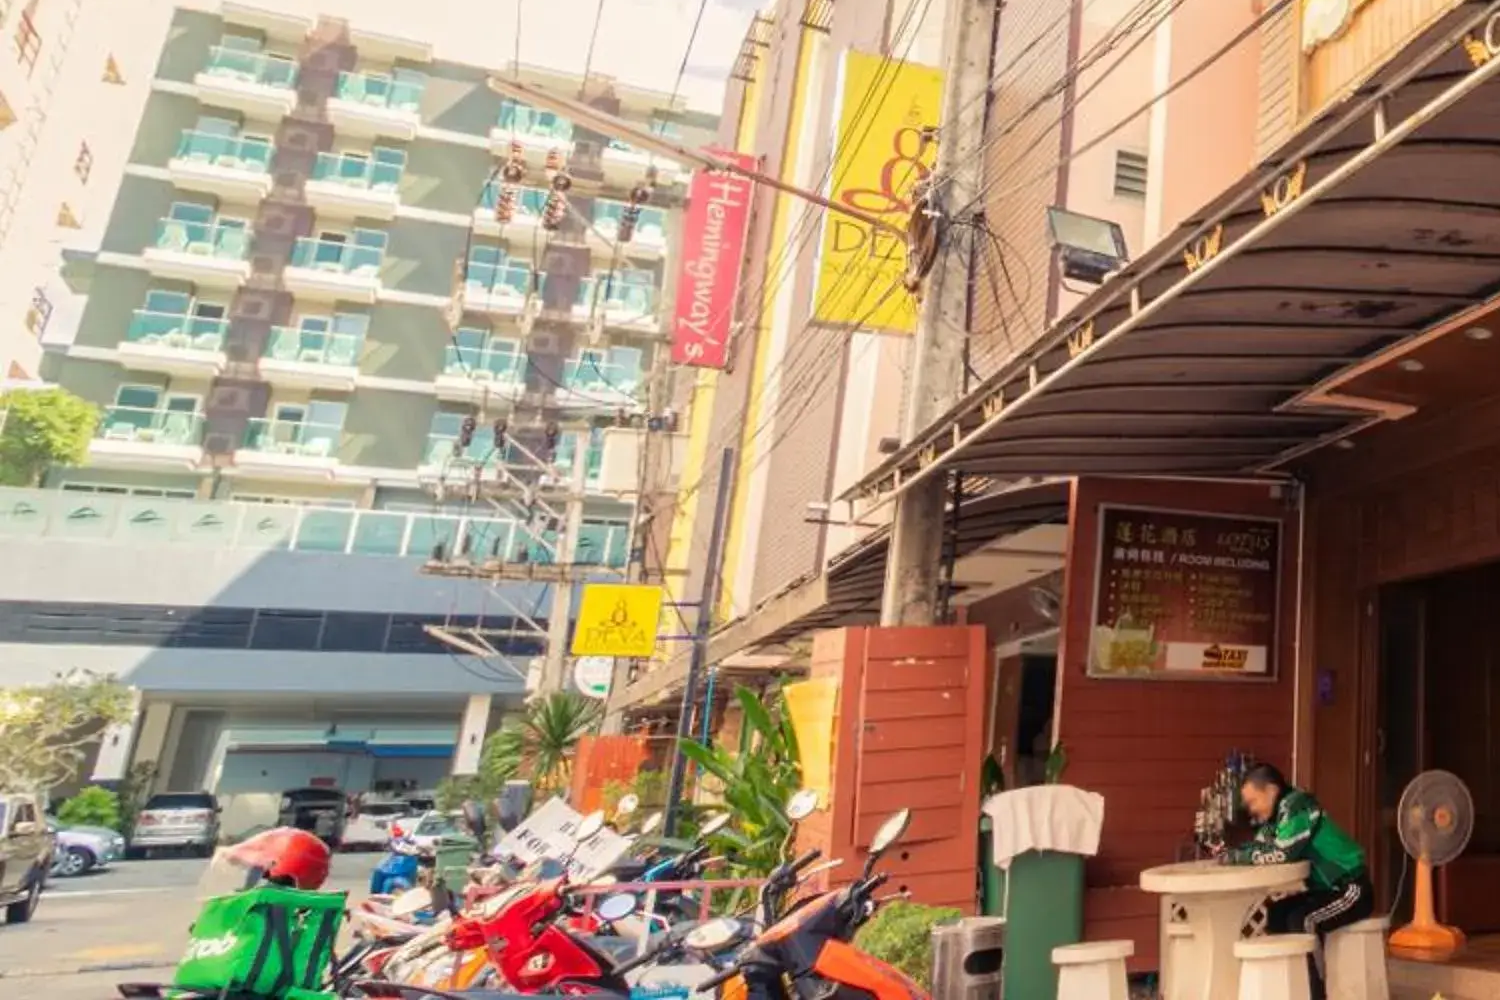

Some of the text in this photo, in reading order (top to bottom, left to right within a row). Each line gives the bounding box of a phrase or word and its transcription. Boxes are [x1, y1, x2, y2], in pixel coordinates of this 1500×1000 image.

[679, 182, 744, 359] Hemingway's
[1178, 553, 1213, 567] ROOM
[1251, 850, 1287, 864] Grab
